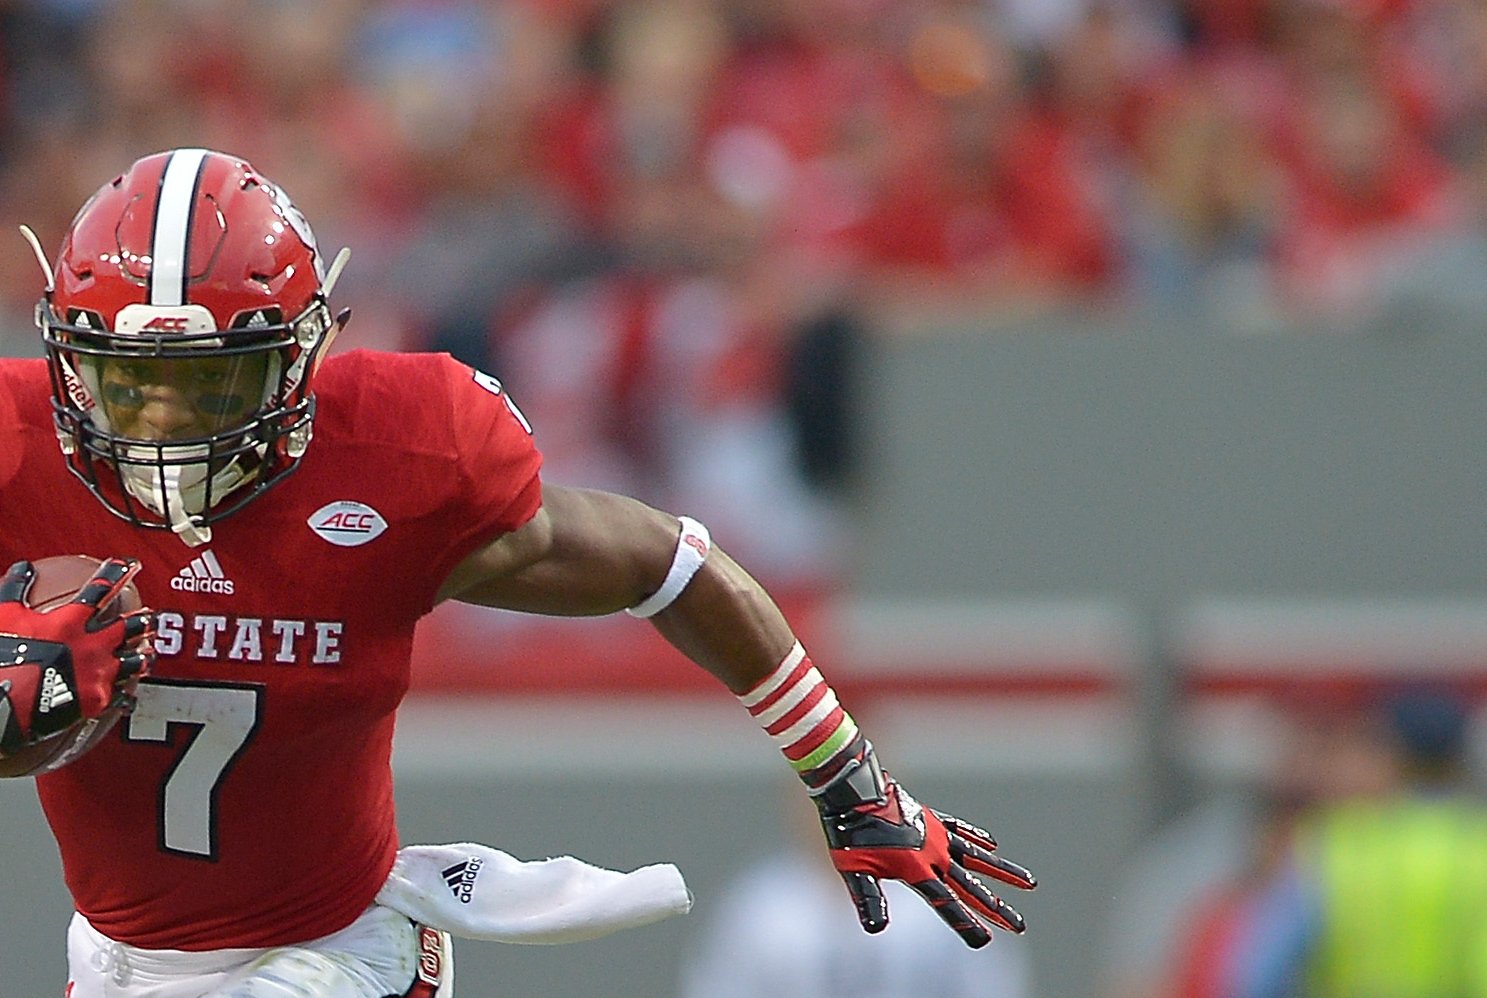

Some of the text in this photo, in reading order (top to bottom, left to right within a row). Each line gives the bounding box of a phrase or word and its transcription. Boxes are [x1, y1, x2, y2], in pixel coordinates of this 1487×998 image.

[320, 512, 375, 530] ACC
[170, 574, 235, 595] adidas
[153, 612, 343, 664] STATE
[38, 667, 57, 713] adidas
[123, 677, 266, 861] 7
[460, 857, 483, 904] adidas
